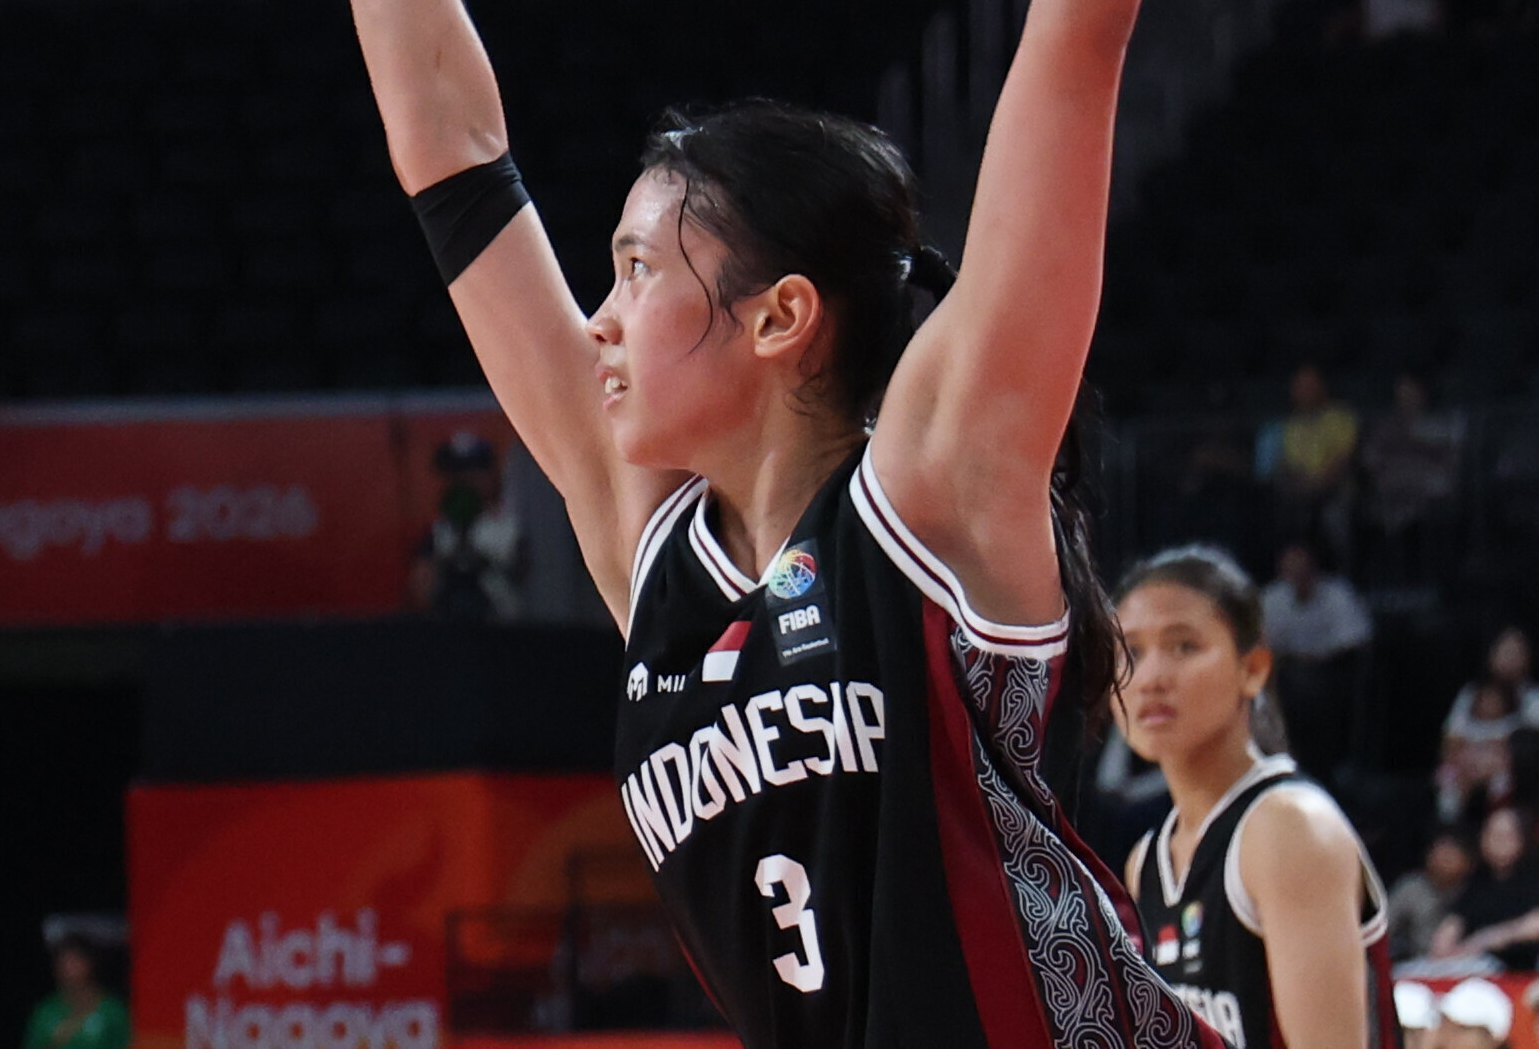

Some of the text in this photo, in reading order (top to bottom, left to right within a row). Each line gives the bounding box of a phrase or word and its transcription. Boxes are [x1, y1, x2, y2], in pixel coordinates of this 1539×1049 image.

[168, 485, 319, 542] 2026
[778, 604, 821, 635] FIBA
[214, 907, 411, 988] Aichi-
[755, 854, 824, 992] 3
